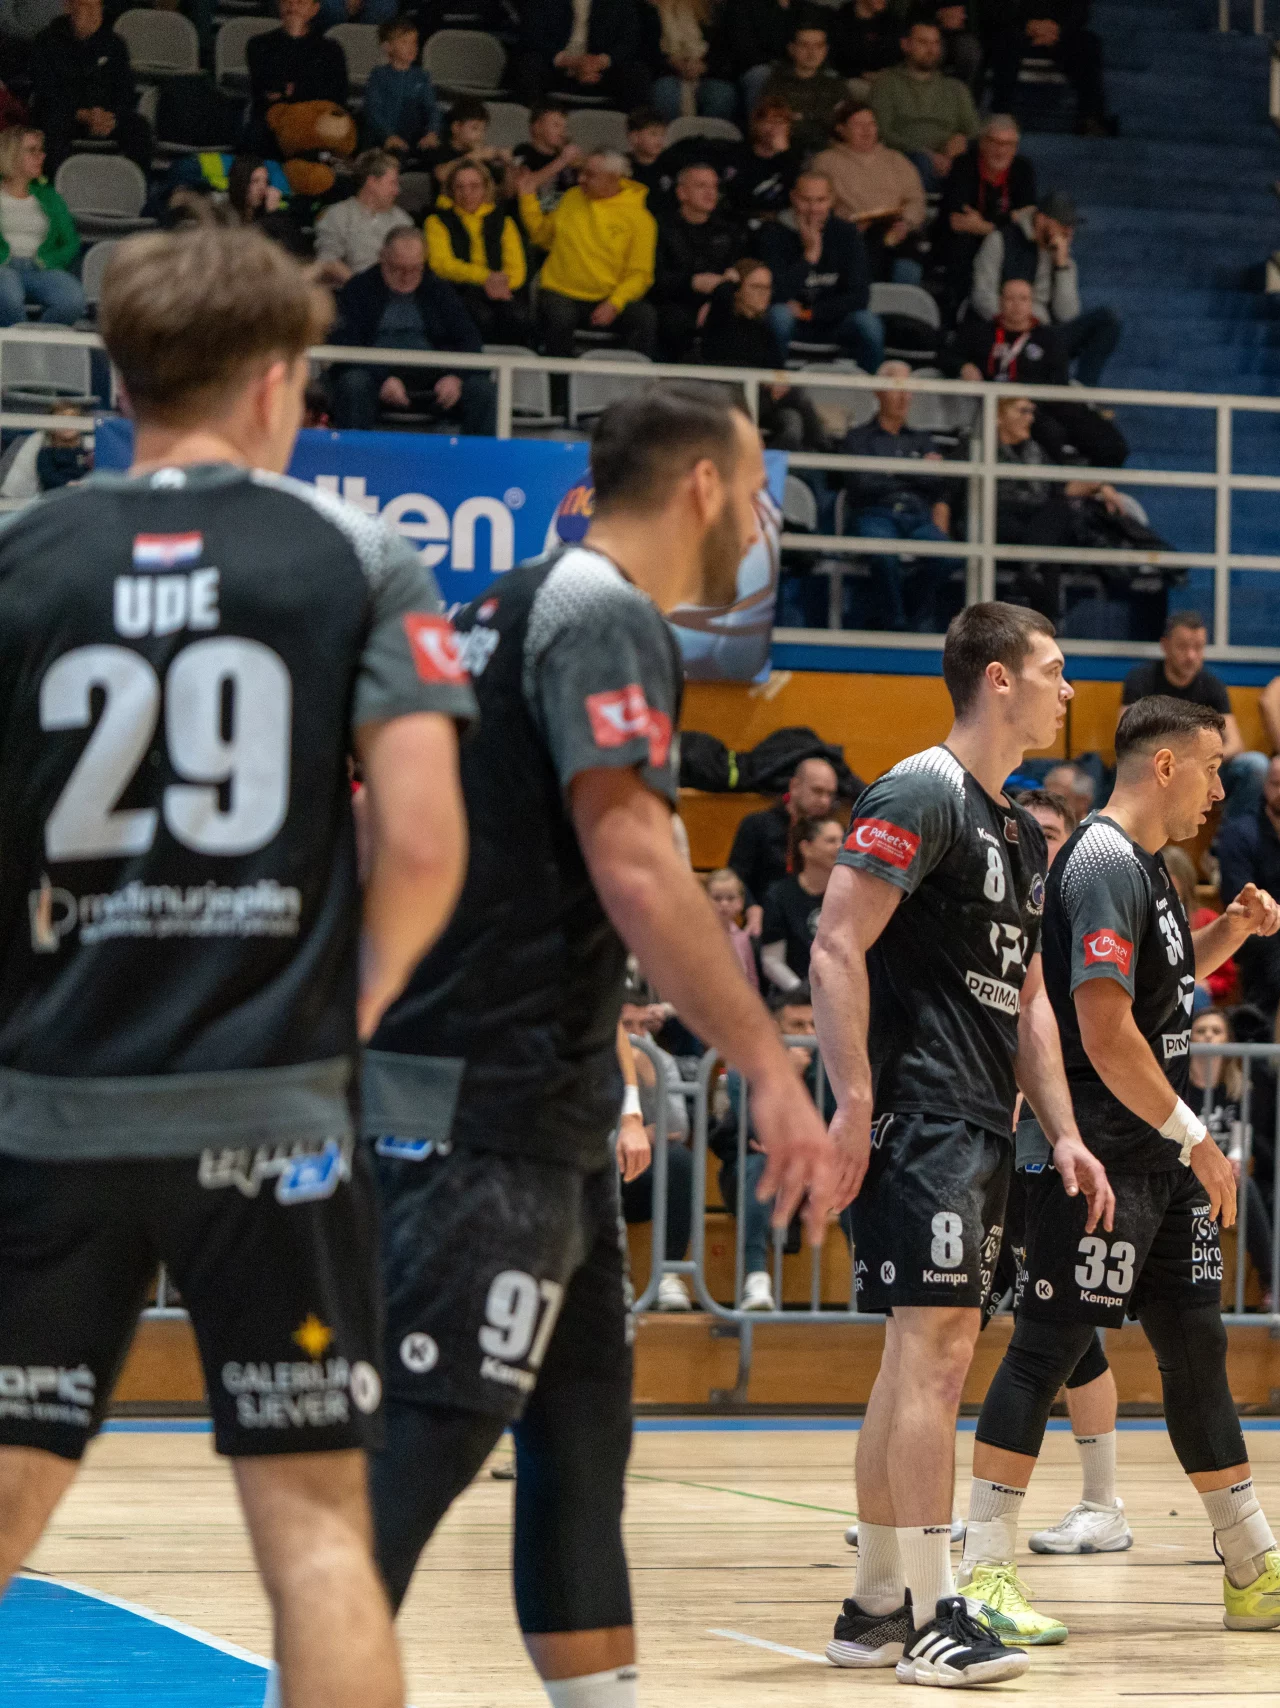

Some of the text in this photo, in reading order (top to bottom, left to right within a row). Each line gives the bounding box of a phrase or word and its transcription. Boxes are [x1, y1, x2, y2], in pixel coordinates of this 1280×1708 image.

[113, 565, 221, 640] UDE
[39, 636, 292, 862] 29
[983, 846, 1006, 902] 8
[1158, 910, 1185, 966] 33
[968, 976, 1016, 1010] PRIMA
[930, 1211, 964, 1269] 8
[1074, 1236, 1136, 1294] 33
[922, 1268, 968, 1287] Kempa
[1079, 1289, 1123, 1307] Kempa
[1191, 1261, 1224, 1284] plus
[477, 1268, 564, 1369] 91
